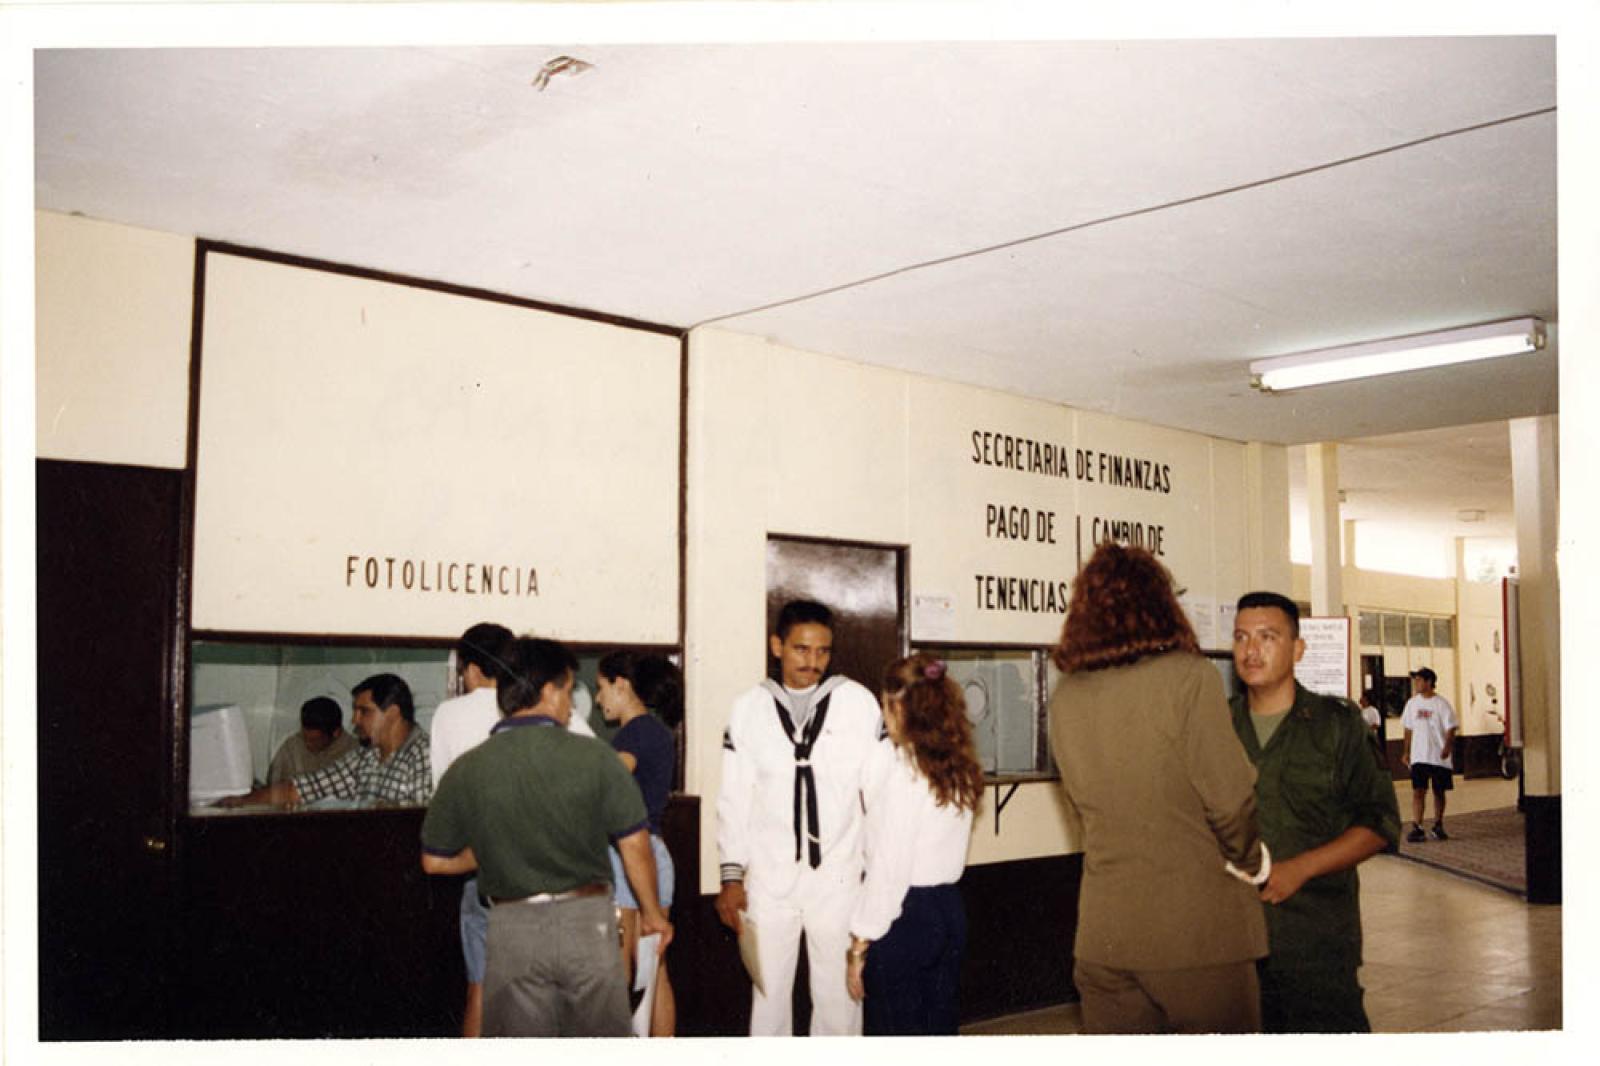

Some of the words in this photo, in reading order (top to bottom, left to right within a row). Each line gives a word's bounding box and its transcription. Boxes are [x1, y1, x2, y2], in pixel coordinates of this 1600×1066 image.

[972, 430, 1069, 479] SECRETARIA
[1076, 448, 1093, 482] DE
[1099, 452, 1170, 494] FINANZAS
[986, 503, 1030, 541] PAGO
[1036, 510, 1056, 544] DE
[1092, 516, 1143, 549] CAMBIO
[1148, 524, 1165, 556] DE
[346, 555, 539, 597] FOTOLICENCIA
[975, 574, 1067, 614] TENENCIAS
